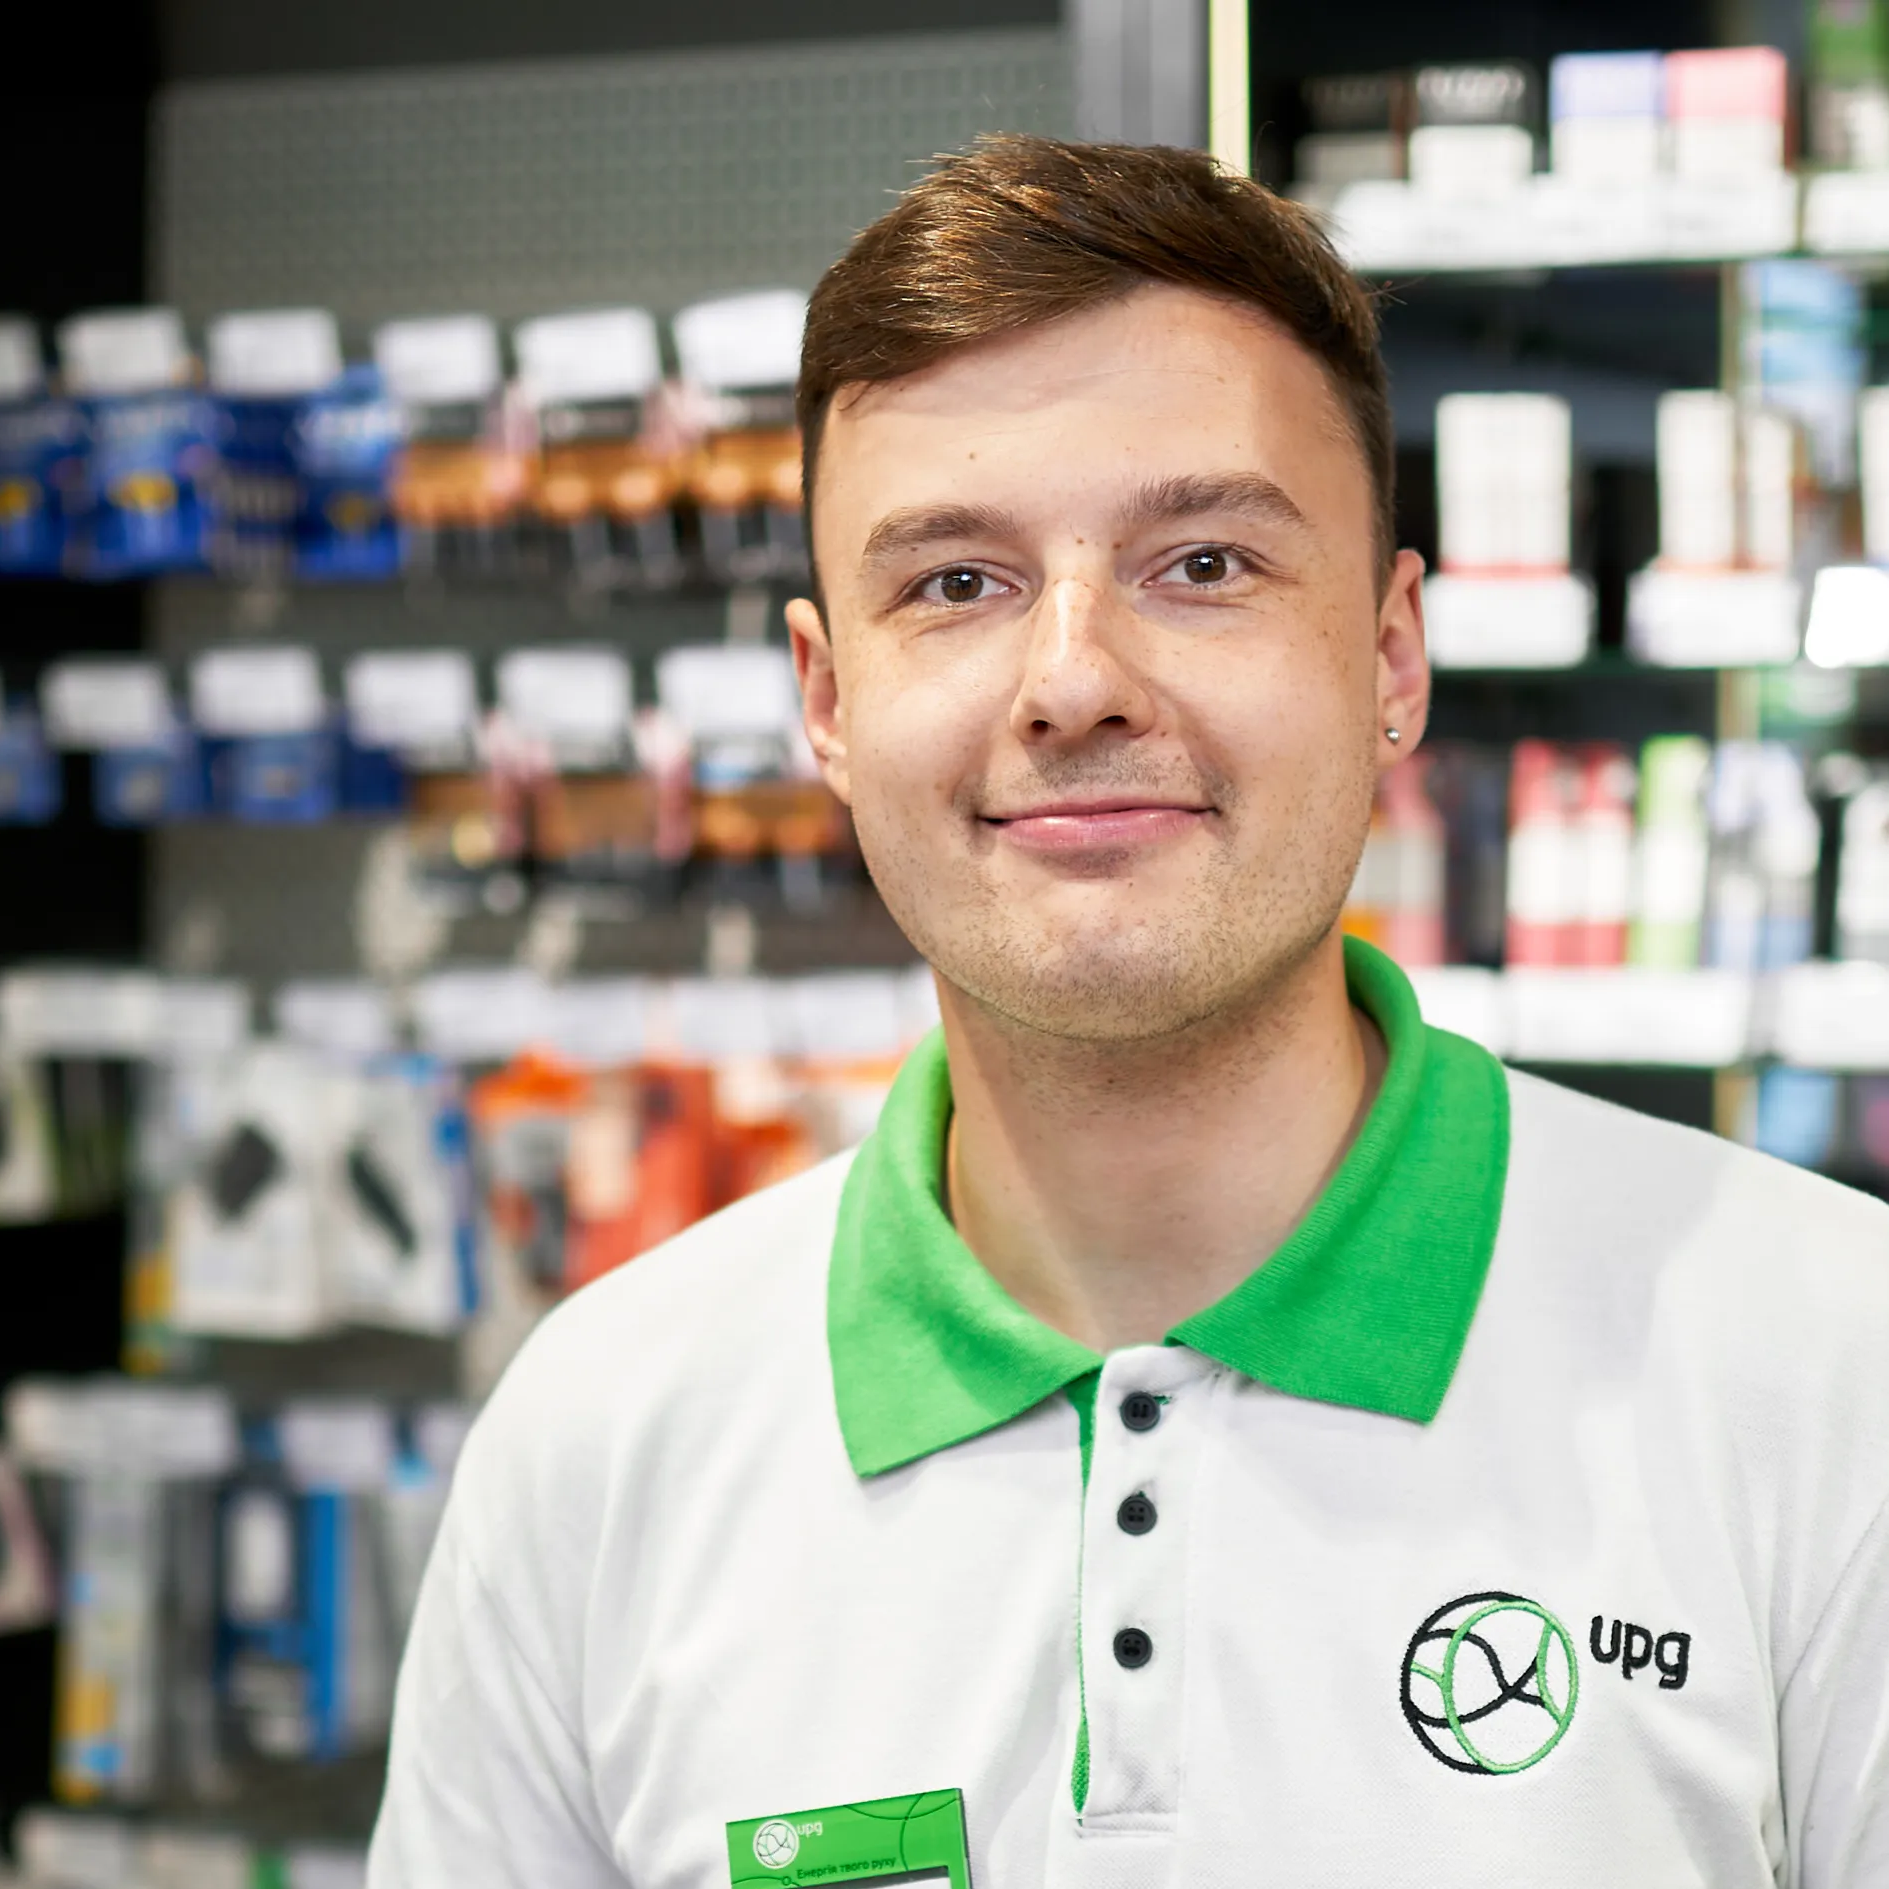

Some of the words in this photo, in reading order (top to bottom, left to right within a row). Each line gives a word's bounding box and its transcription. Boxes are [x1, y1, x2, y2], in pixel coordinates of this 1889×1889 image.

[1589, 1614, 1692, 1691] upg
[796, 1819, 824, 1838] upg
[796, 1862, 838, 1879] Енергія
[839, 1859, 870, 1874] твого
[872, 1856, 897, 1873] руху
